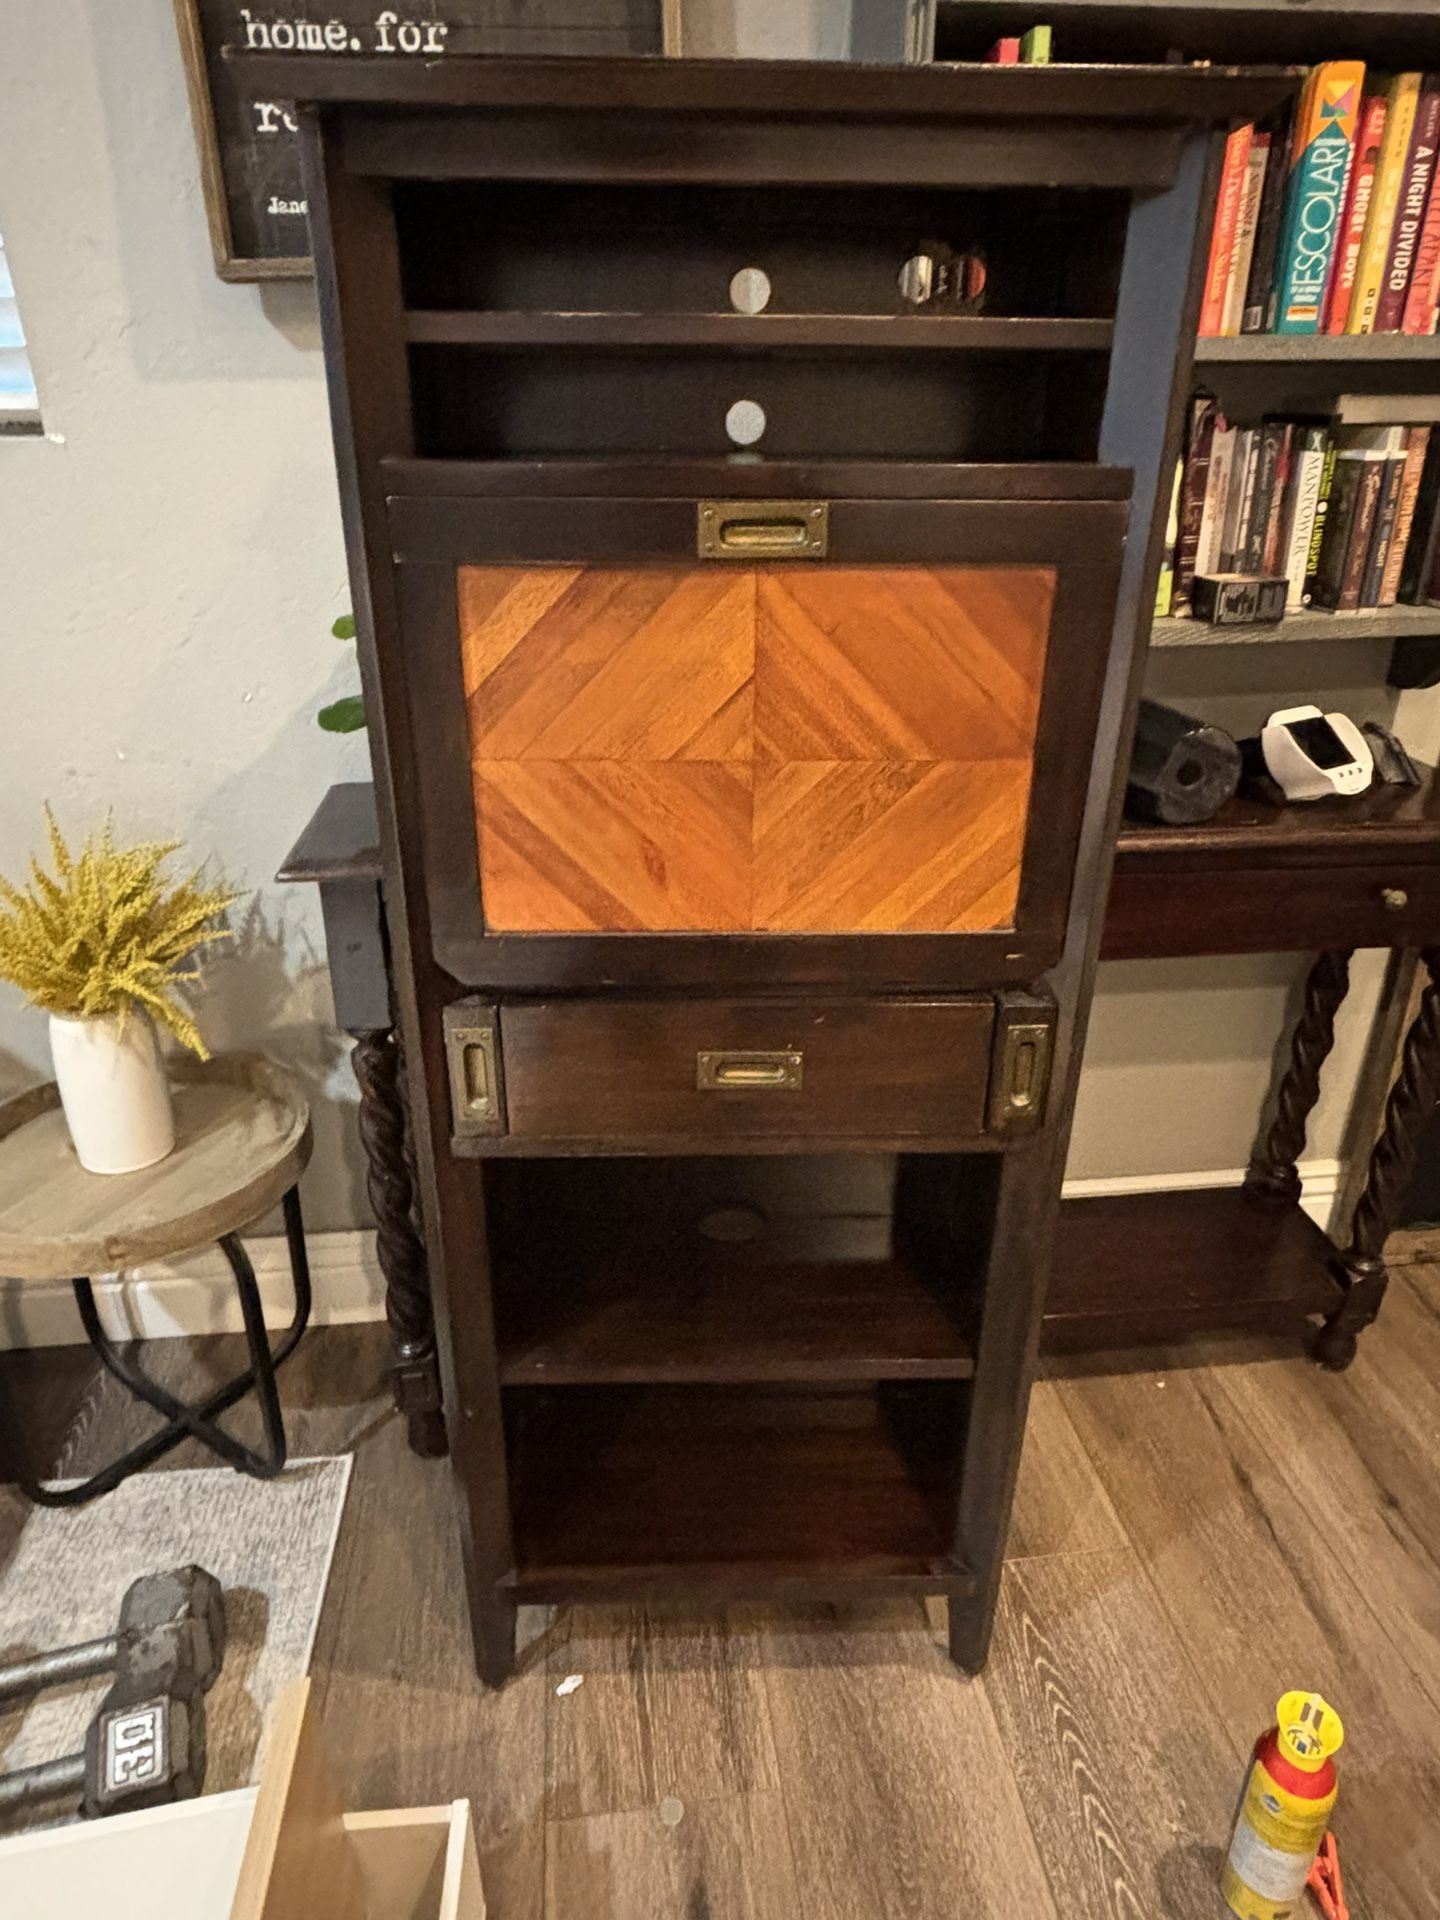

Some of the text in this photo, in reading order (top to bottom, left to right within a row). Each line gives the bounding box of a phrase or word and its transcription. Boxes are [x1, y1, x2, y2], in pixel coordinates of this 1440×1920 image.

[374, 11, 449, 53] for
[1416, 145, 1434, 159] A
[1352, 174, 1374, 233] GHOST
[1405, 164, 1432, 217] NIGHT
[1389, 219, 1418, 291] DIVIDED
[1292, 455, 1322, 558] MANPOWER
[1306, 514, 1327, 577] BLINDSPOT
[113, 1710, 155, 1786] 30
